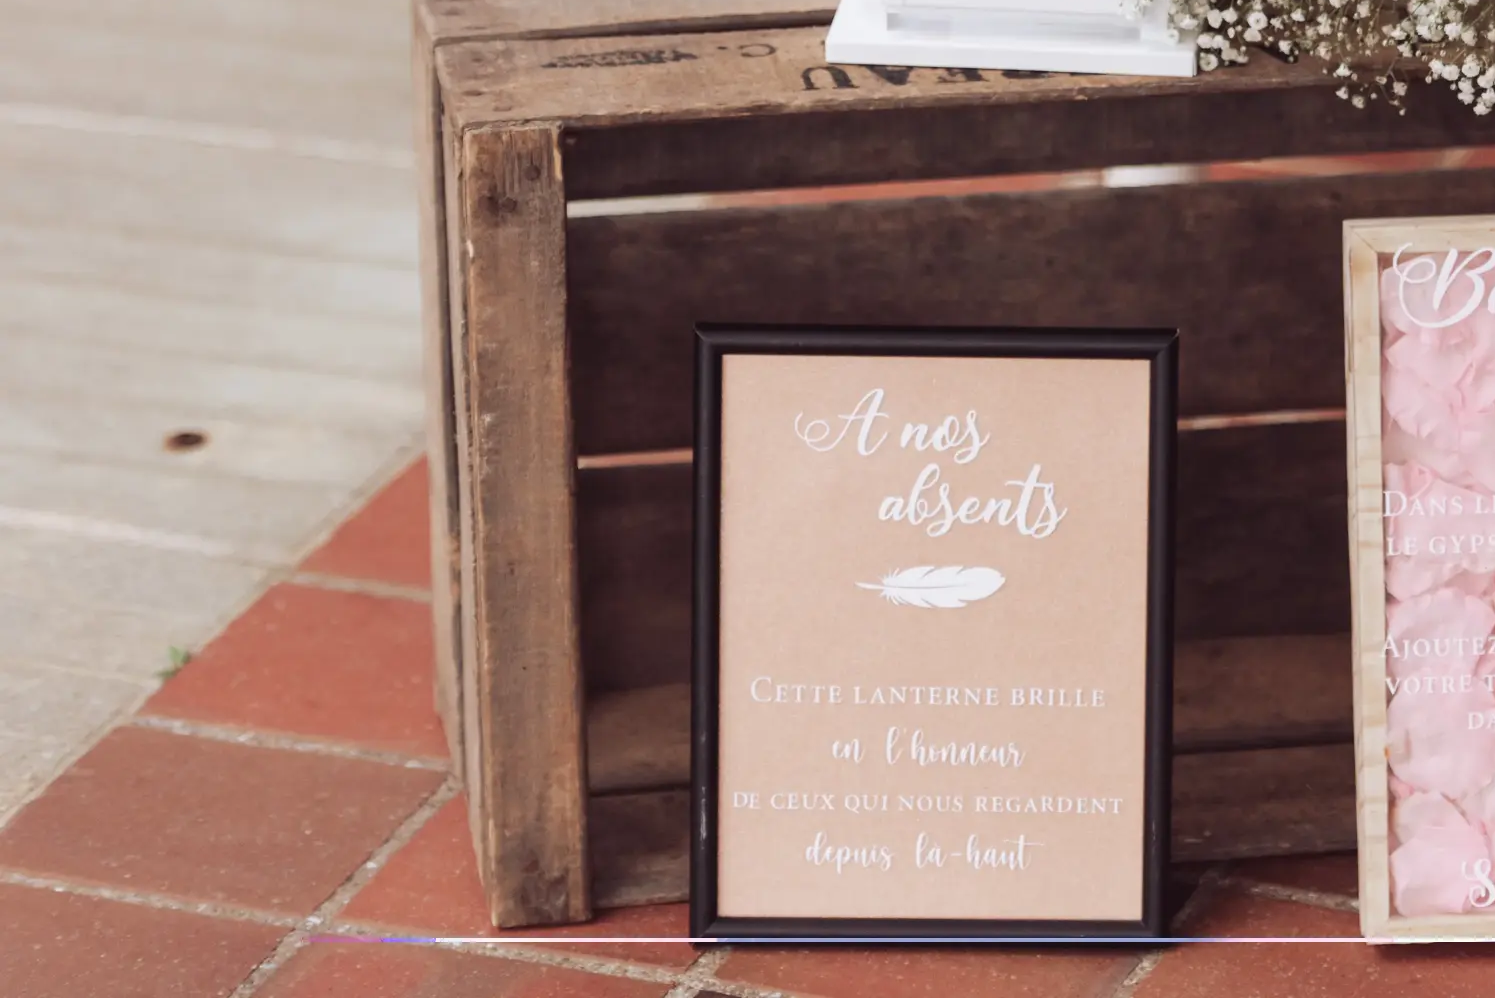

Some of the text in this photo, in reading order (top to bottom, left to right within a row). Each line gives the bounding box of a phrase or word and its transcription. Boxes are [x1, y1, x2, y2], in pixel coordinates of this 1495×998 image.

[794, 388, 991, 465] A nos
[878, 463, 1068, 539] absents
[1383, 490, 1463, 517] DANS
[1387, 536, 1418, 556] LE
[853, 686, 1000, 707] LANTERNE
[1010, 687, 1107, 708] BRILLE
[1384, 673, 1473, 696] VOTRE
[831, 726, 1026, 768] en l'honneur
[732, 791, 1124, 815] DE CEUX QUI NOUS REGARDENT
[804, 831, 896, 875] depuis
